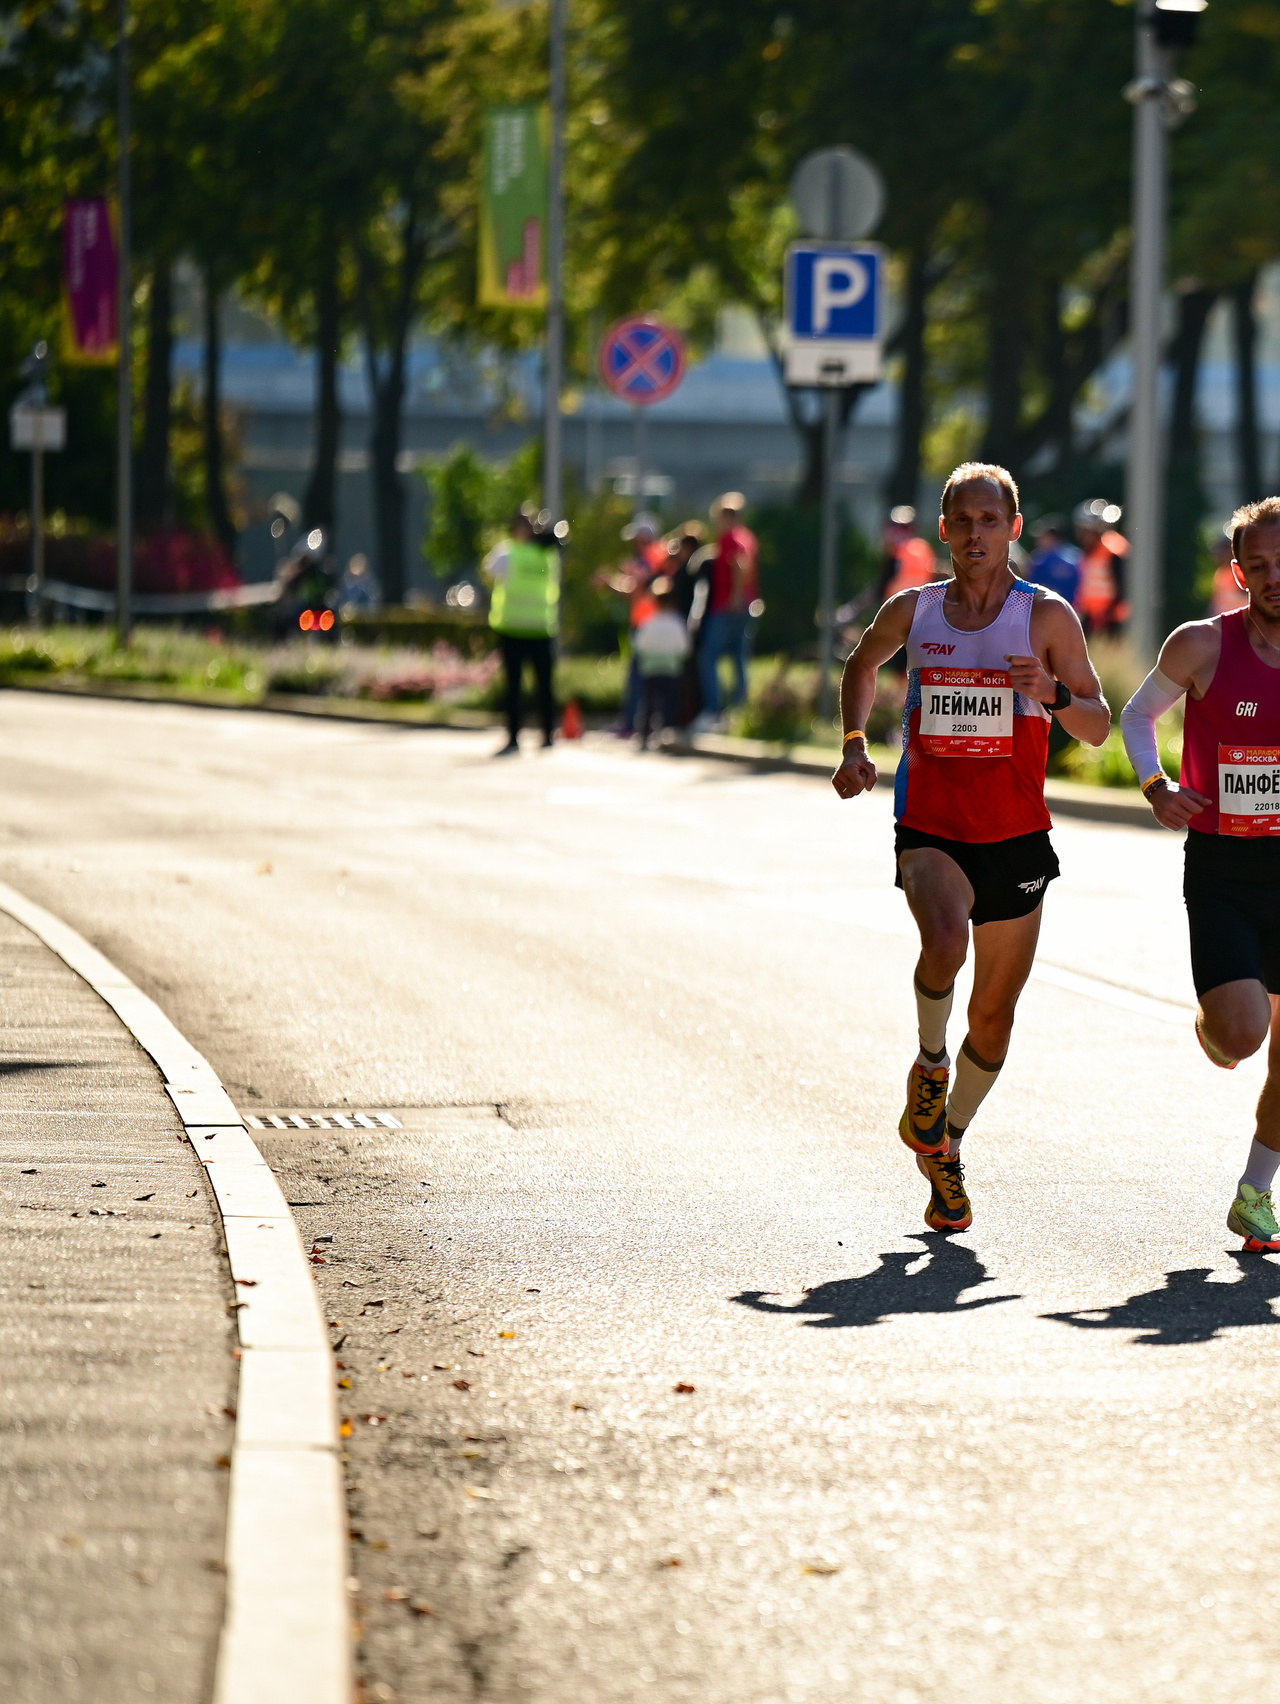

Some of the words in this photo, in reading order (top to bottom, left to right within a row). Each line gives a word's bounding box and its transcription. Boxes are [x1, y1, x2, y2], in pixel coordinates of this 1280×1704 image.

[813, 257, 869, 332] P
[920, 643, 956, 655] RAY
[929, 691, 1002, 716] ЛЕЙМАН
[951, 724, 978, 732] 22003
[1254, 802, 1280, 811] 22018
[1017, 876, 1045, 894] RAY
